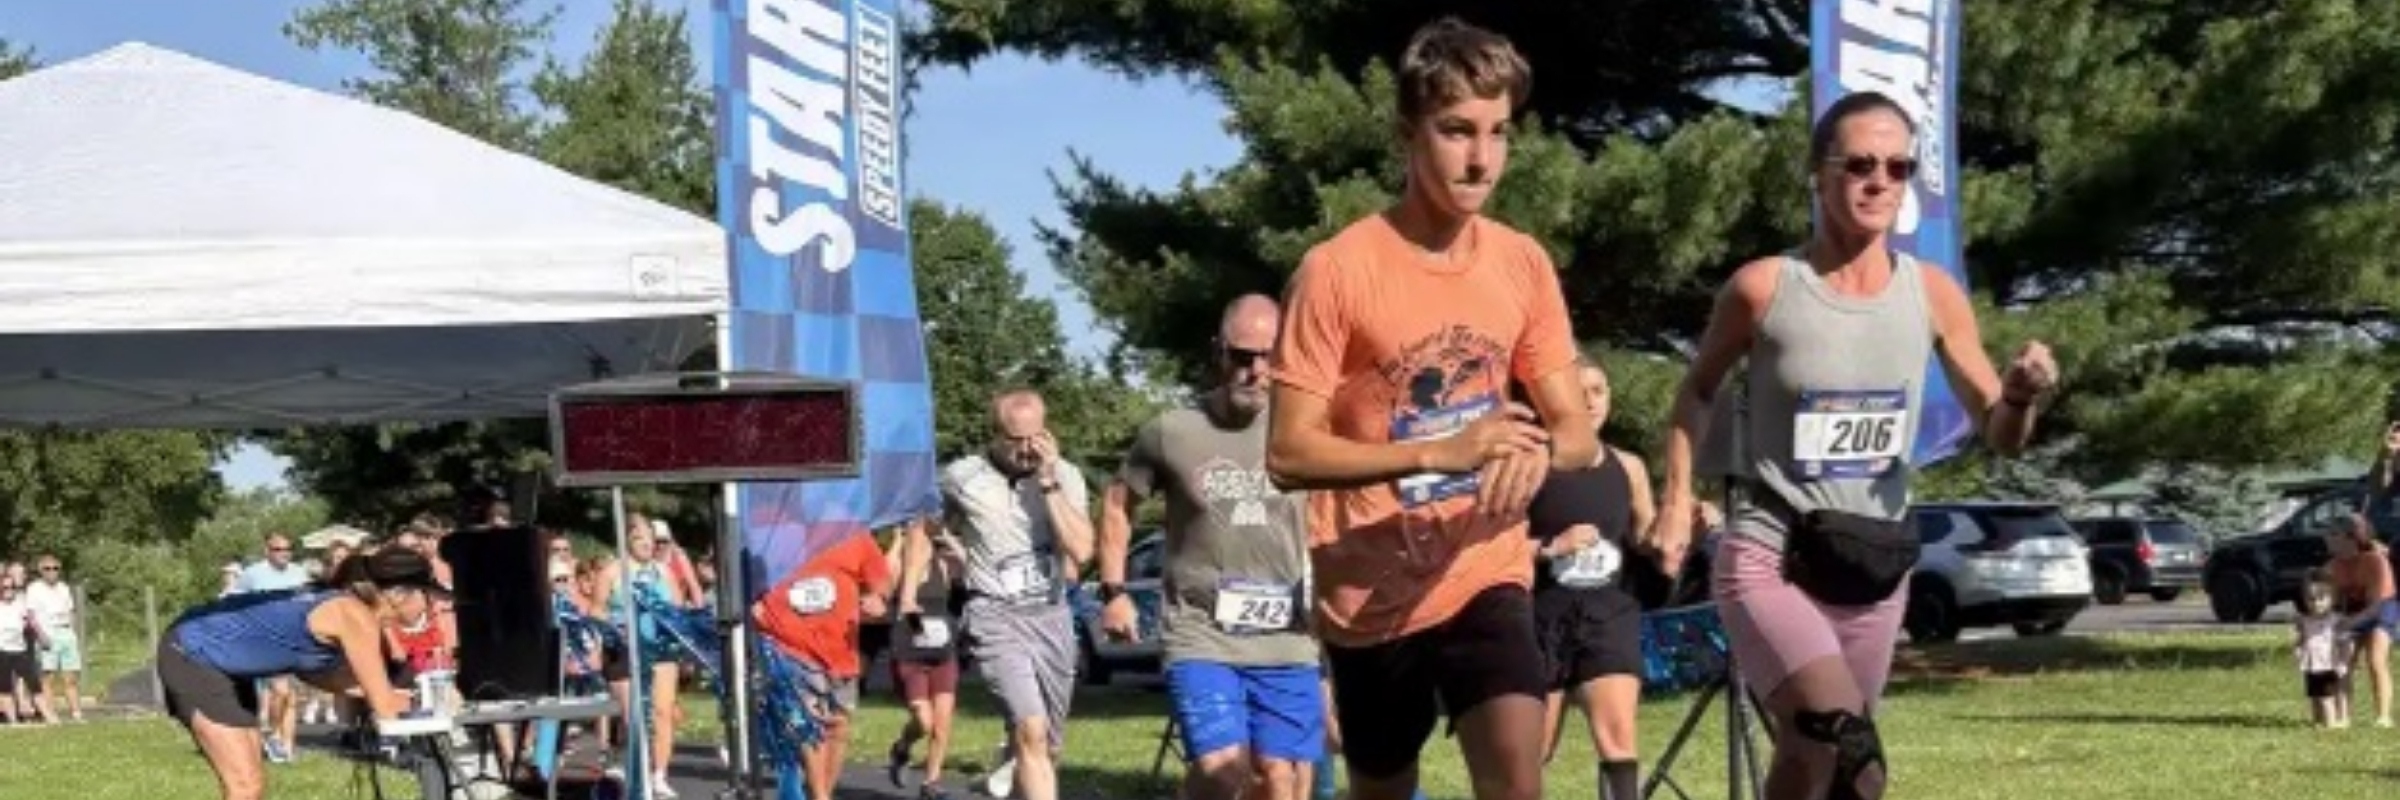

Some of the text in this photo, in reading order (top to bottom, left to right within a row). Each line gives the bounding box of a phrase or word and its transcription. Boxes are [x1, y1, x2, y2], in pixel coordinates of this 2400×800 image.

[859, 12, 897, 221] SPEEDY FEET
[1828, 417, 1895, 453] 206
[1238, 601, 1285, 624] 242
